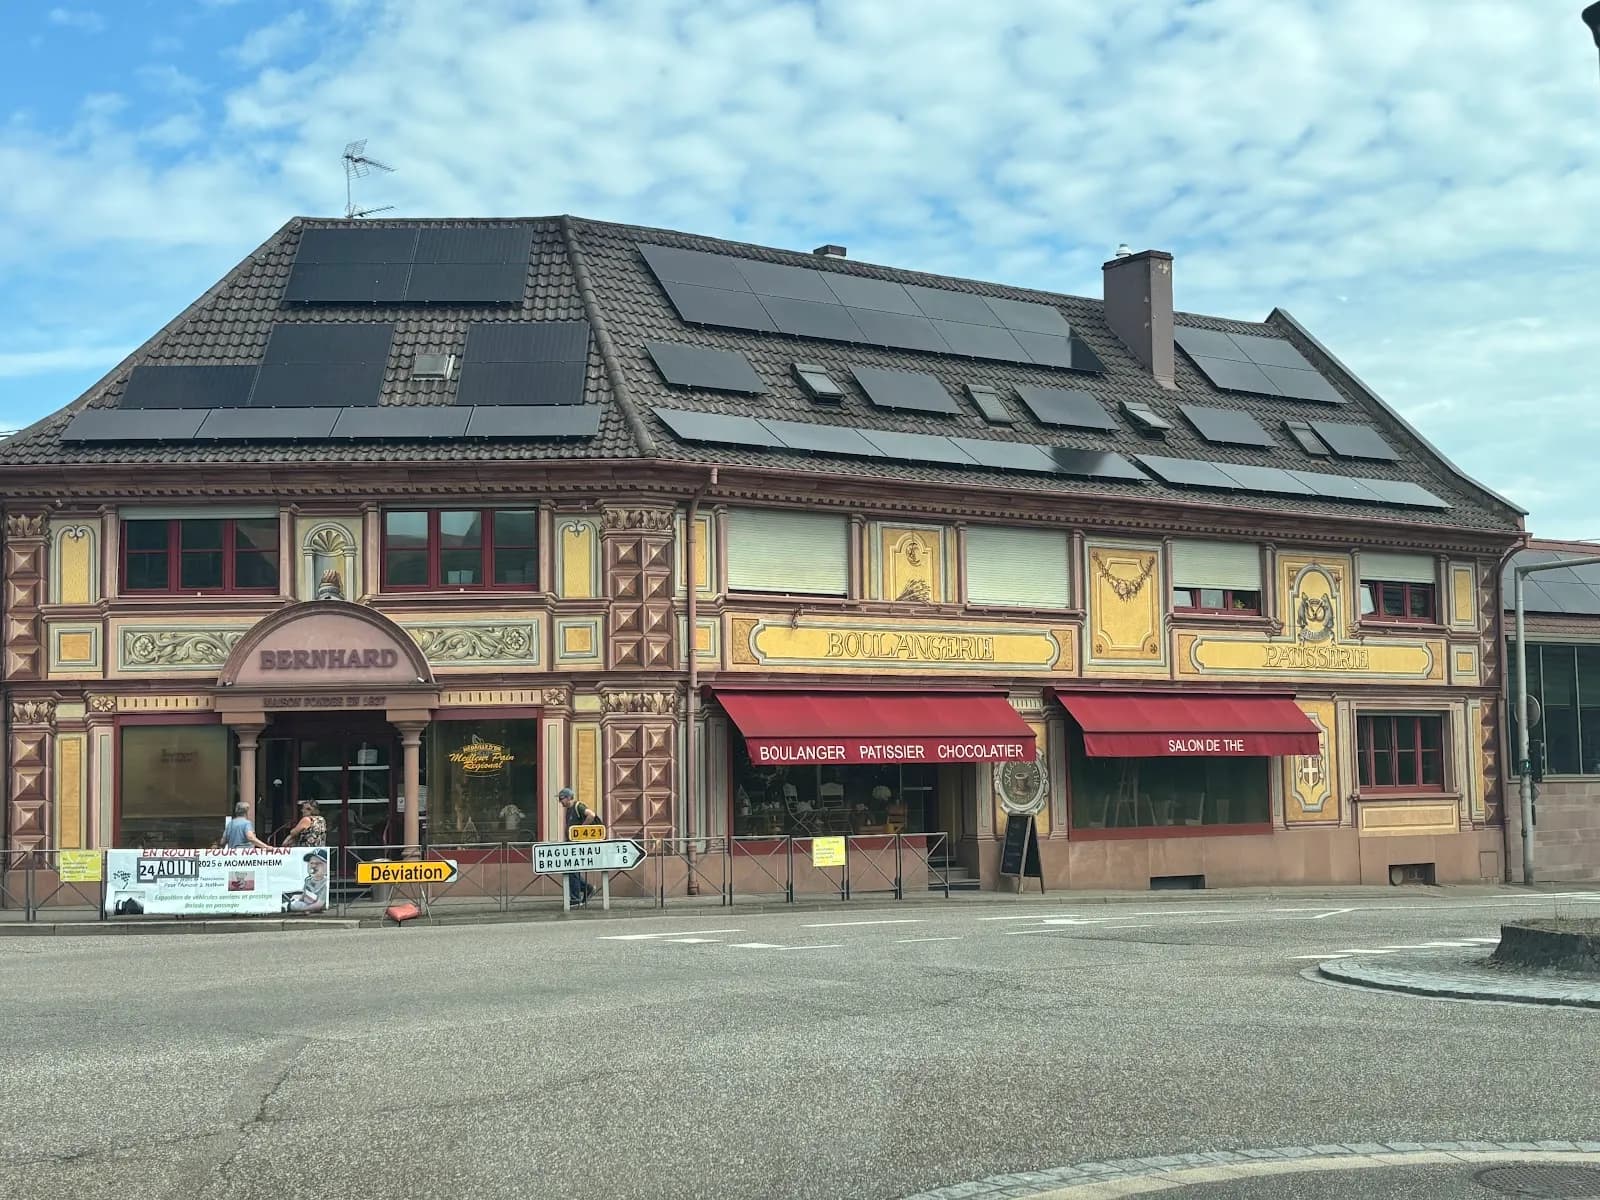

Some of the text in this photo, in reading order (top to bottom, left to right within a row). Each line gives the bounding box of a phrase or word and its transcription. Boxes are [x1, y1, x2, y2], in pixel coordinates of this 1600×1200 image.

[824, 632, 995, 661] BOULANGERIE
[259, 648, 399, 671] BERNHARD
[1262, 646, 1370, 670] PATISSERIE
[759, 744, 1025, 761] BOULANGER PATISSIER CHOCOLATIER
[1168, 739, 1245, 752] SALON DE THE
[491, 752, 515, 762] Pain
[573, 828, 602, 838] D 421
[143, 847, 291, 857] EN ROUTE POUR NATHAN
[538, 845, 628, 858] HAGUENAU 15
[140, 865, 155, 876] 24
[157, 859, 196, 876] AOUT
[224, 859, 283, 867] MOMMENHEIM
[539, 855, 628, 869] BRUMATH 6
[371, 865, 443, 882] Déviation
